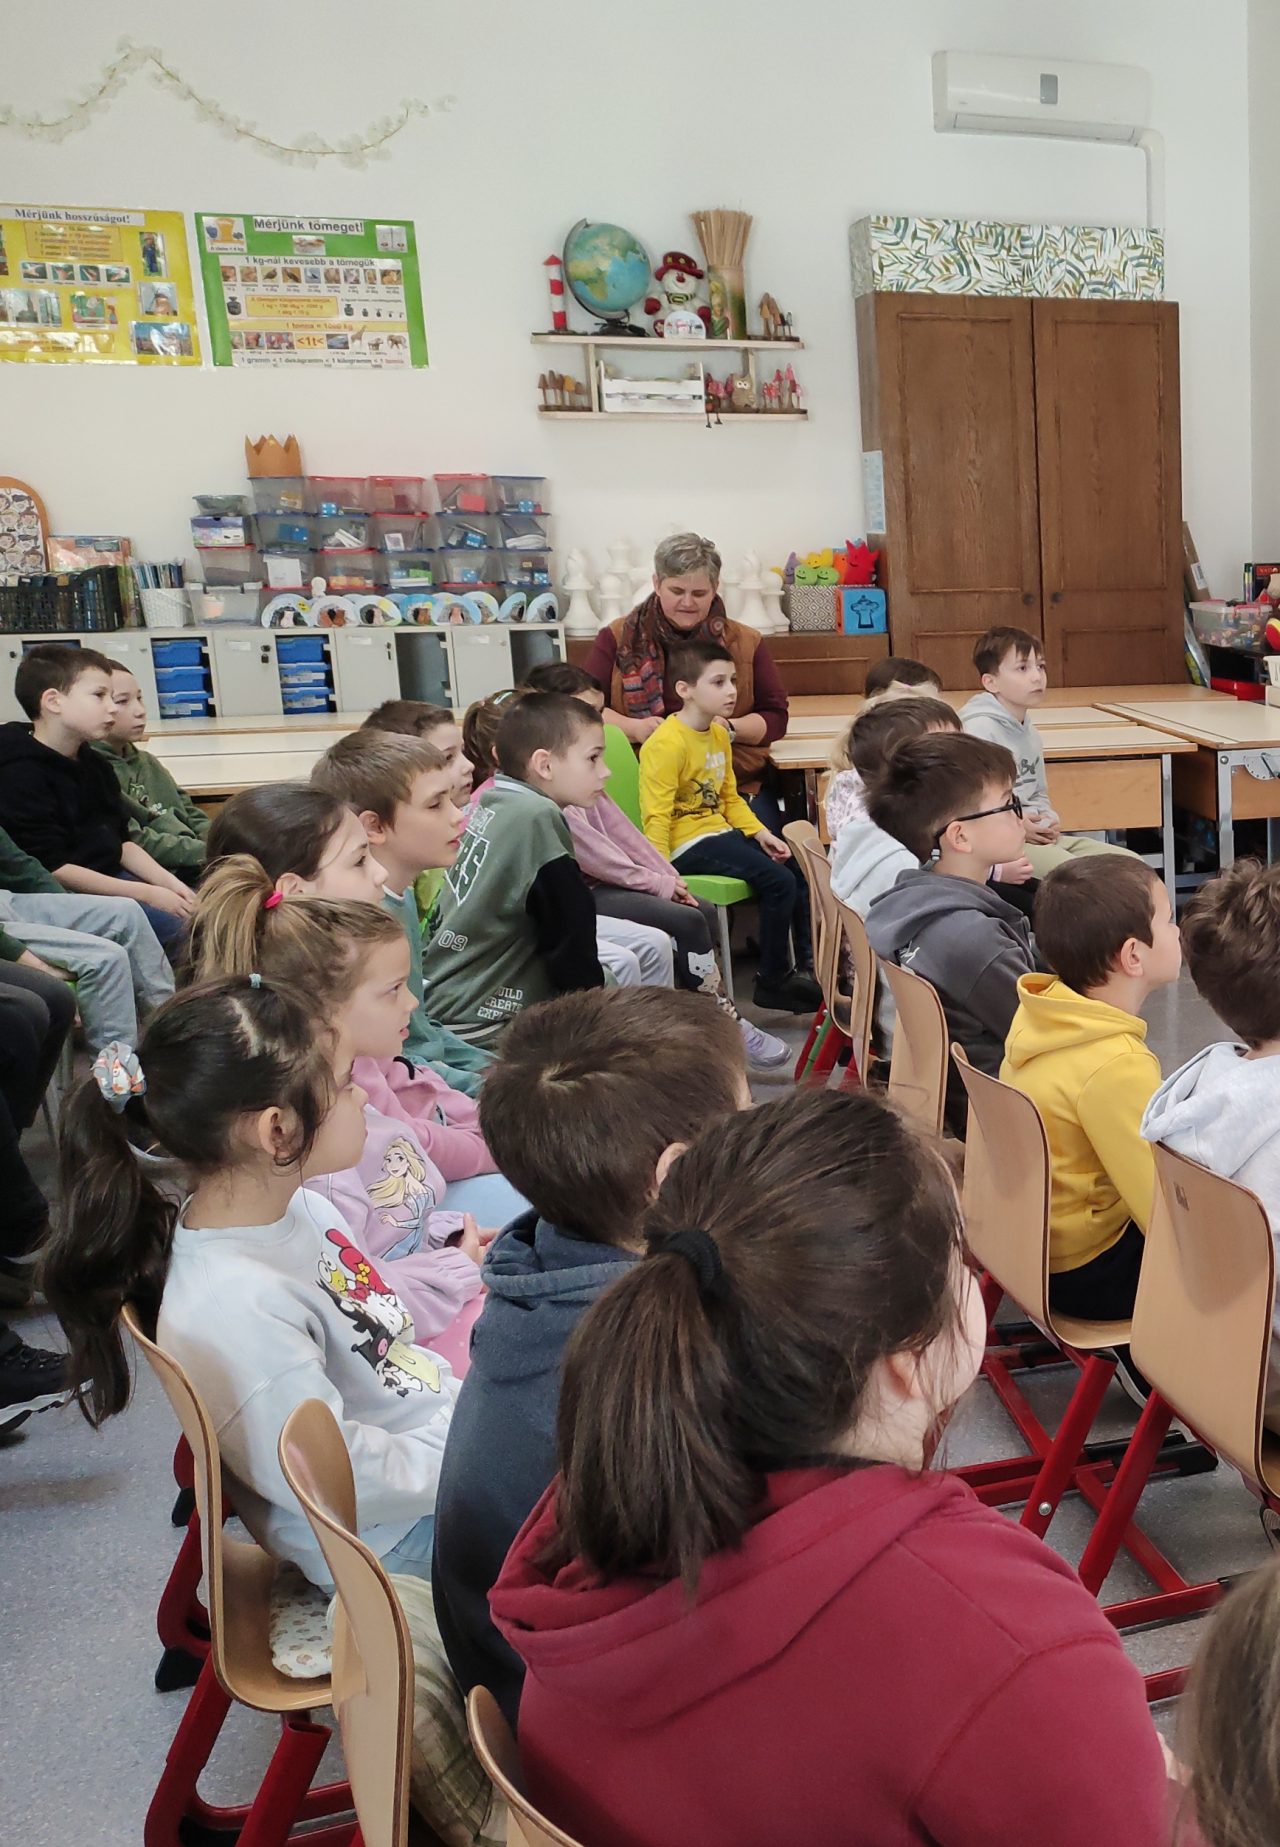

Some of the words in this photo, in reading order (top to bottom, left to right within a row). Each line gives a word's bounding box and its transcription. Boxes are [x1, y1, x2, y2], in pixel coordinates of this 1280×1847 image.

[14, 208, 62, 222] Mérjünk
[65, 210, 131, 224] hosszúságot!
[254, 218, 305, 233] Mérjünk
[308, 219, 364, 234] tömeget!
[245, 256, 250, 264] 1
[438, 930, 469, 952] 09
[495, 986, 523, 1001] UILD
